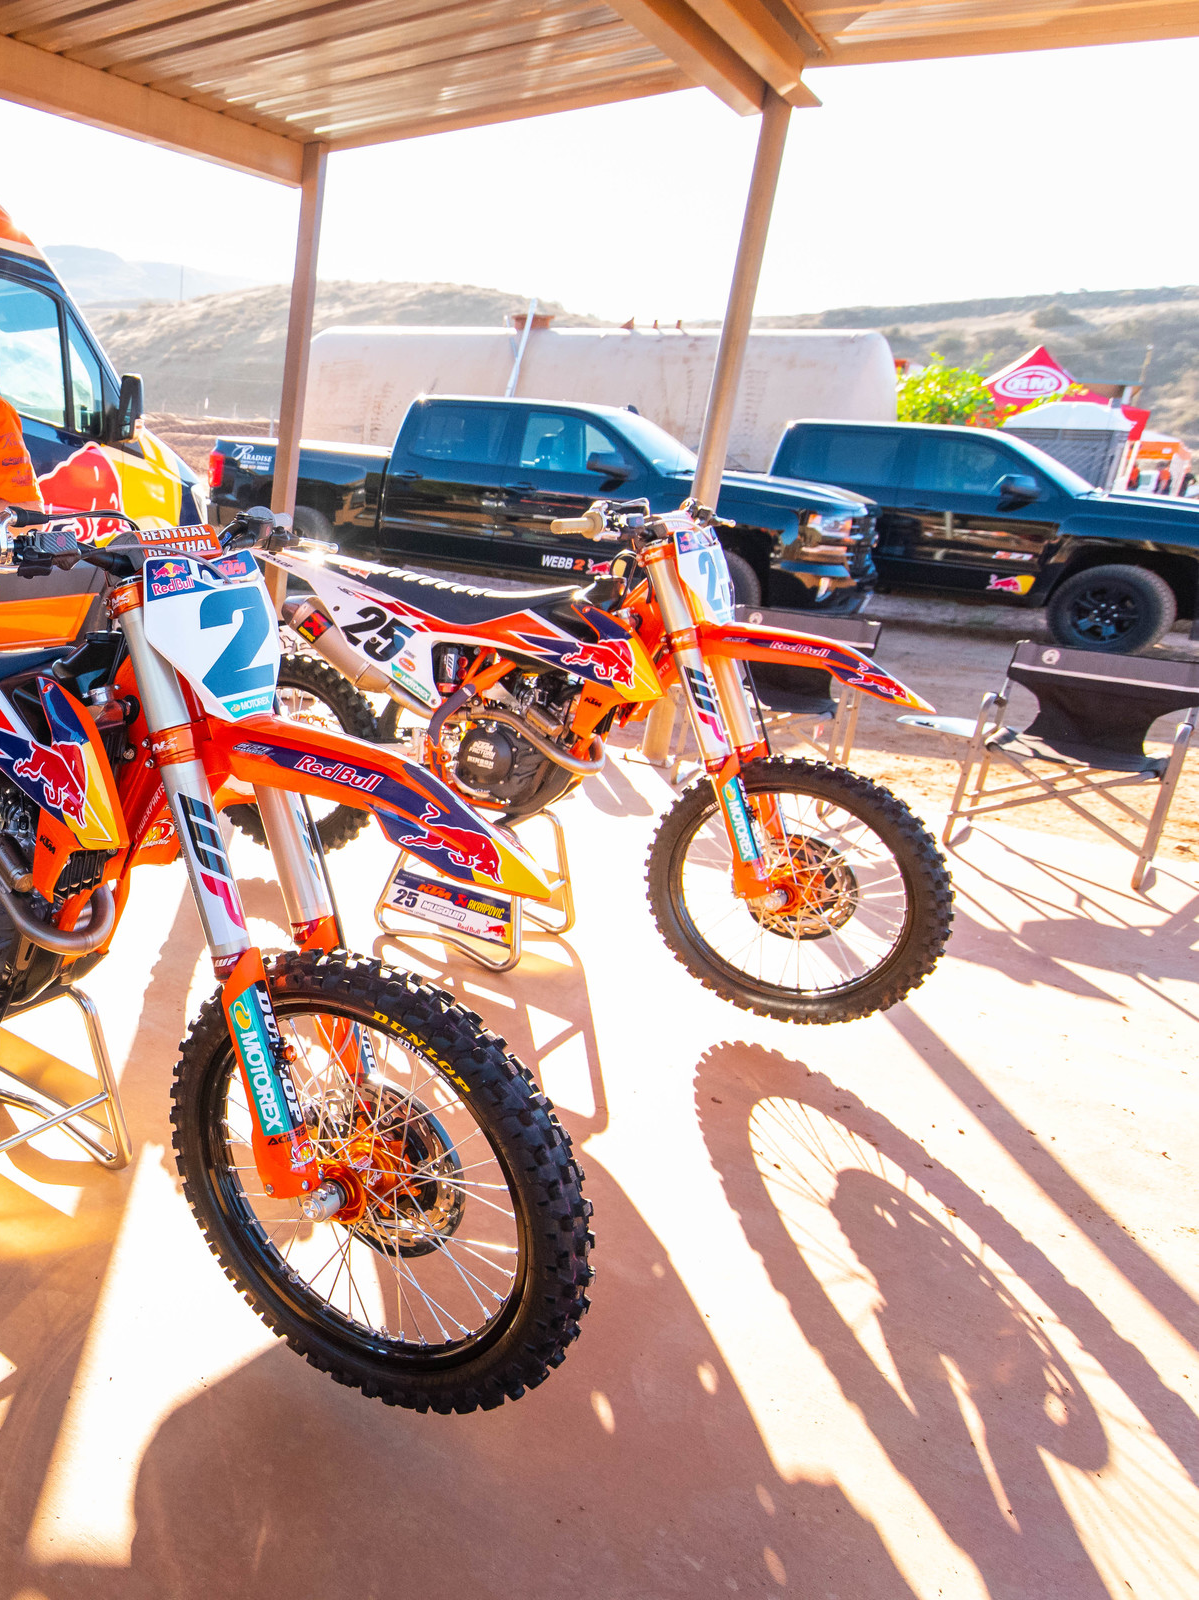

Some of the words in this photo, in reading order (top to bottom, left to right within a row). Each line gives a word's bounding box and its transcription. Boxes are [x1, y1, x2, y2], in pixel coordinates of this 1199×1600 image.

[141, 524, 211, 541] RENTHAL
[541, 554, 573, 570] WEBB
[573, 559, 587, 571] 2
[151, 582, 176, 596] Red
[175, 577, 195, 591] Bull
[200, 586, 275, 698] 2
[340, 606, 416, 662] 25
[769, 640, 801, 653] Red
[799, 645, 831, 658] Bull
[240, 695, 270, 711] MOTOREX
[584, 697, 602, 708] KTM
[293, 755, 338, 779] Red
[332, 762, 383, 792] Bull
[728, 800, 755, 860] MOTOREX
[39, 834, 56, 855] KTM
[417, 883, 452, 901] KTM
[393, 888, 420, 909] 25
[420, 900, 466, 922] MUSQUIN
[214, 955, 240, 968] WP
[372, 1011, 471, 1093] DUNLOP
[240, 1030, 284, 1132] MOTOREX
